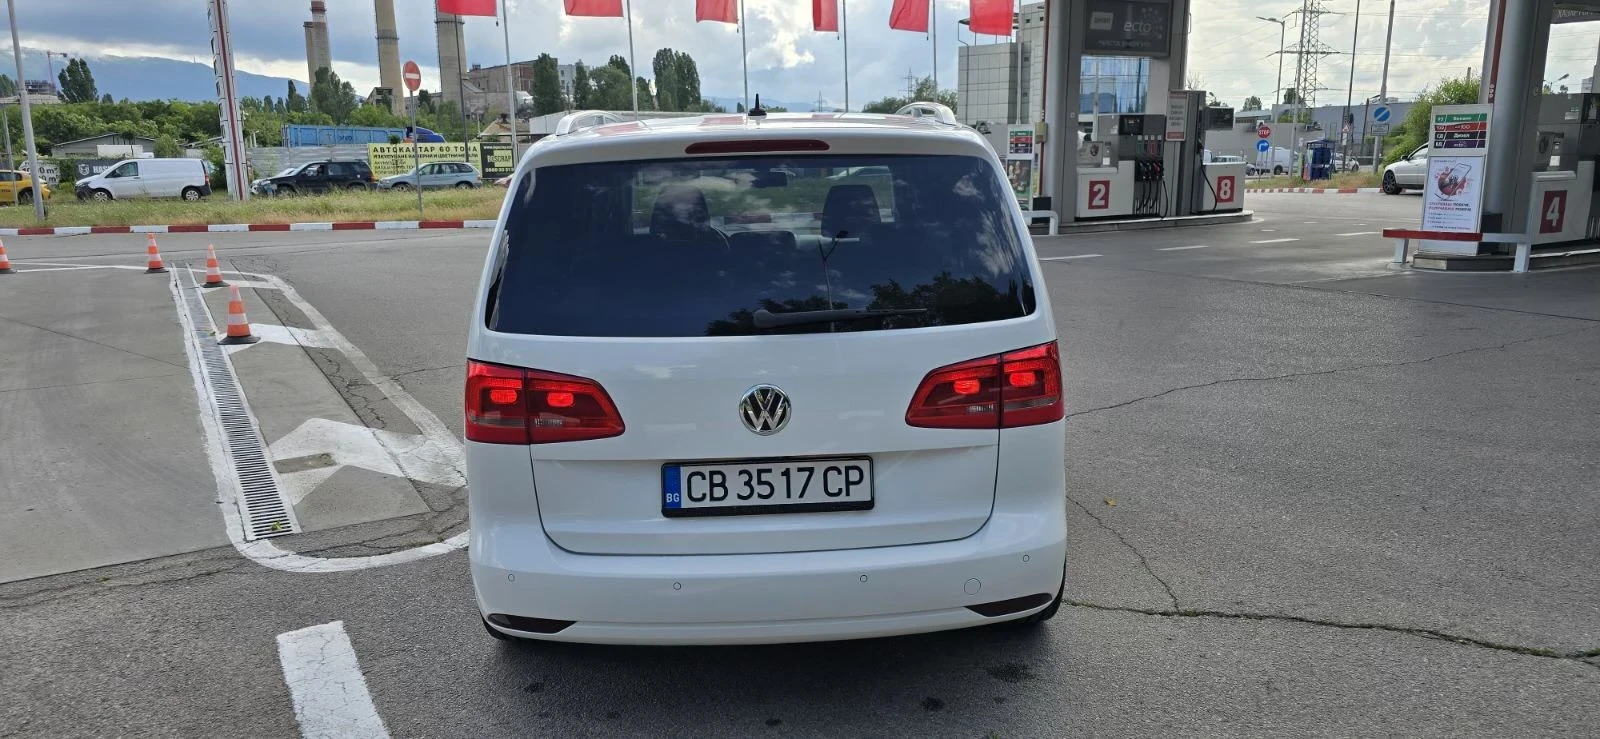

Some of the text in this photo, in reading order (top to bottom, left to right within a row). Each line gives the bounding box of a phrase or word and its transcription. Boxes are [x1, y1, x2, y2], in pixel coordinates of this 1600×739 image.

[1092, 184, 1106, 206] 2
[1220, 179, 1231, 199] 8
[1546, 197, 1560, 226] 4
[687, 465, 864, 502] CB 3517 CP
[666, 493, 680, 503] BG
